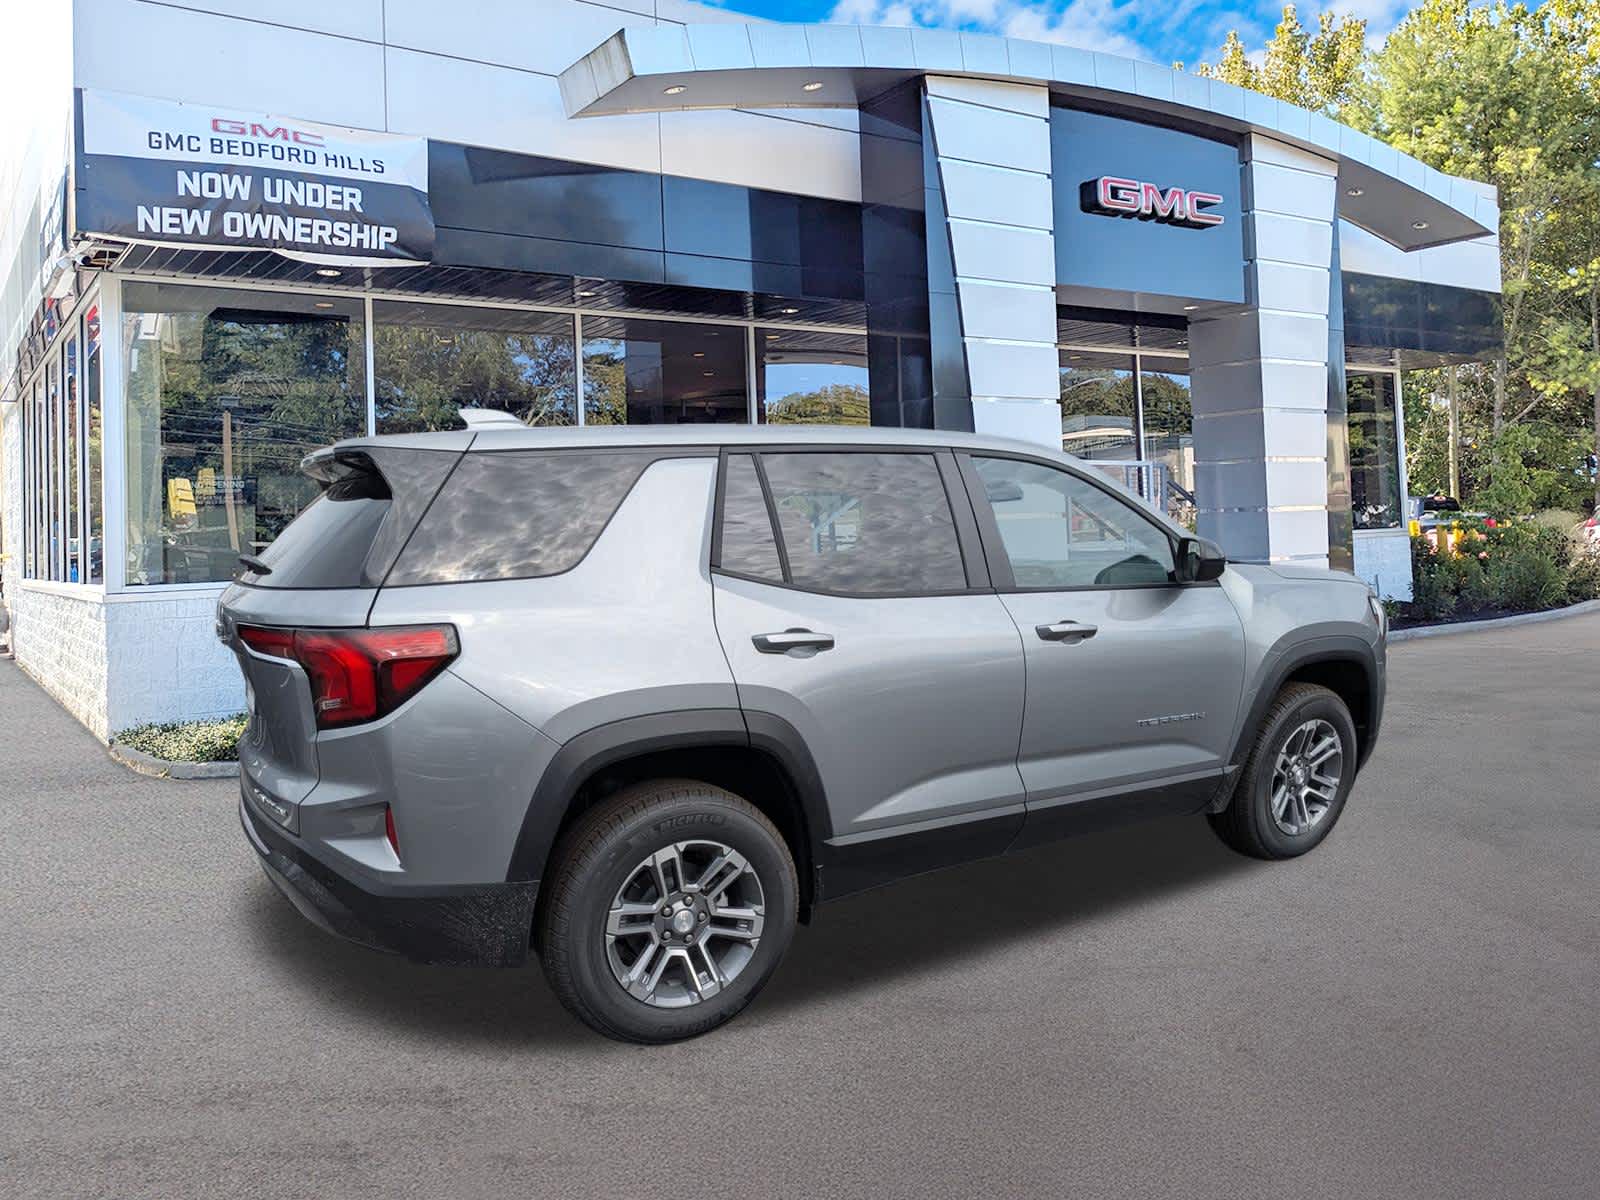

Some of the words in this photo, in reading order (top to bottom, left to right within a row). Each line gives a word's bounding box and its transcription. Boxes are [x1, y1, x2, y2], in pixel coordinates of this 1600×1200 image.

[148, 131, 200, 152] GMC
[210, 138, 317, 165] BEDFORD
[324, 153, 385, 174] HILLS
[211, 118, 326, 148] GMC
[177, 170, 252, 201] NOW
[263, 176, 364, 213] UNDER
[1097, 175, 1225, 225] GMC
[136, 205, 212, 236] NEW
[223, 210, 398, 250] OWNERSHIP
